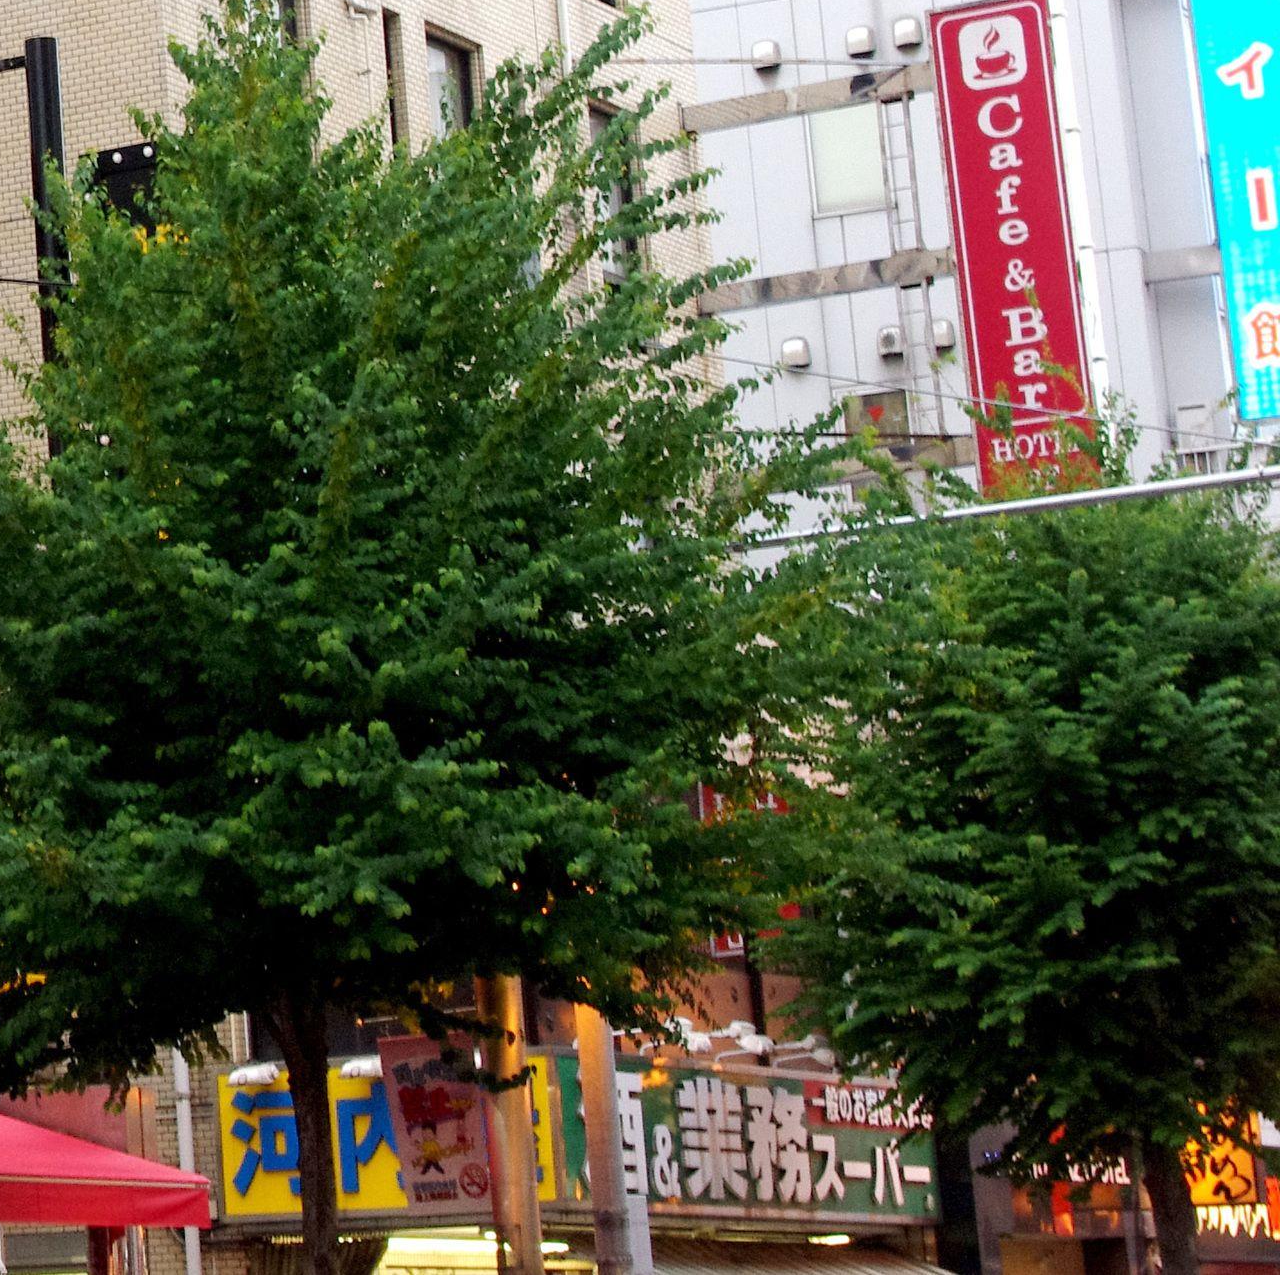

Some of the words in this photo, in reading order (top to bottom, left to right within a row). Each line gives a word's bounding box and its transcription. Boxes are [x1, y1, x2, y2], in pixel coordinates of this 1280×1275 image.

[977, 94, 1030, 247] Cafe
[1004, 259, 1035, 292] &
[1002, 307, 1047, 411] Bar
